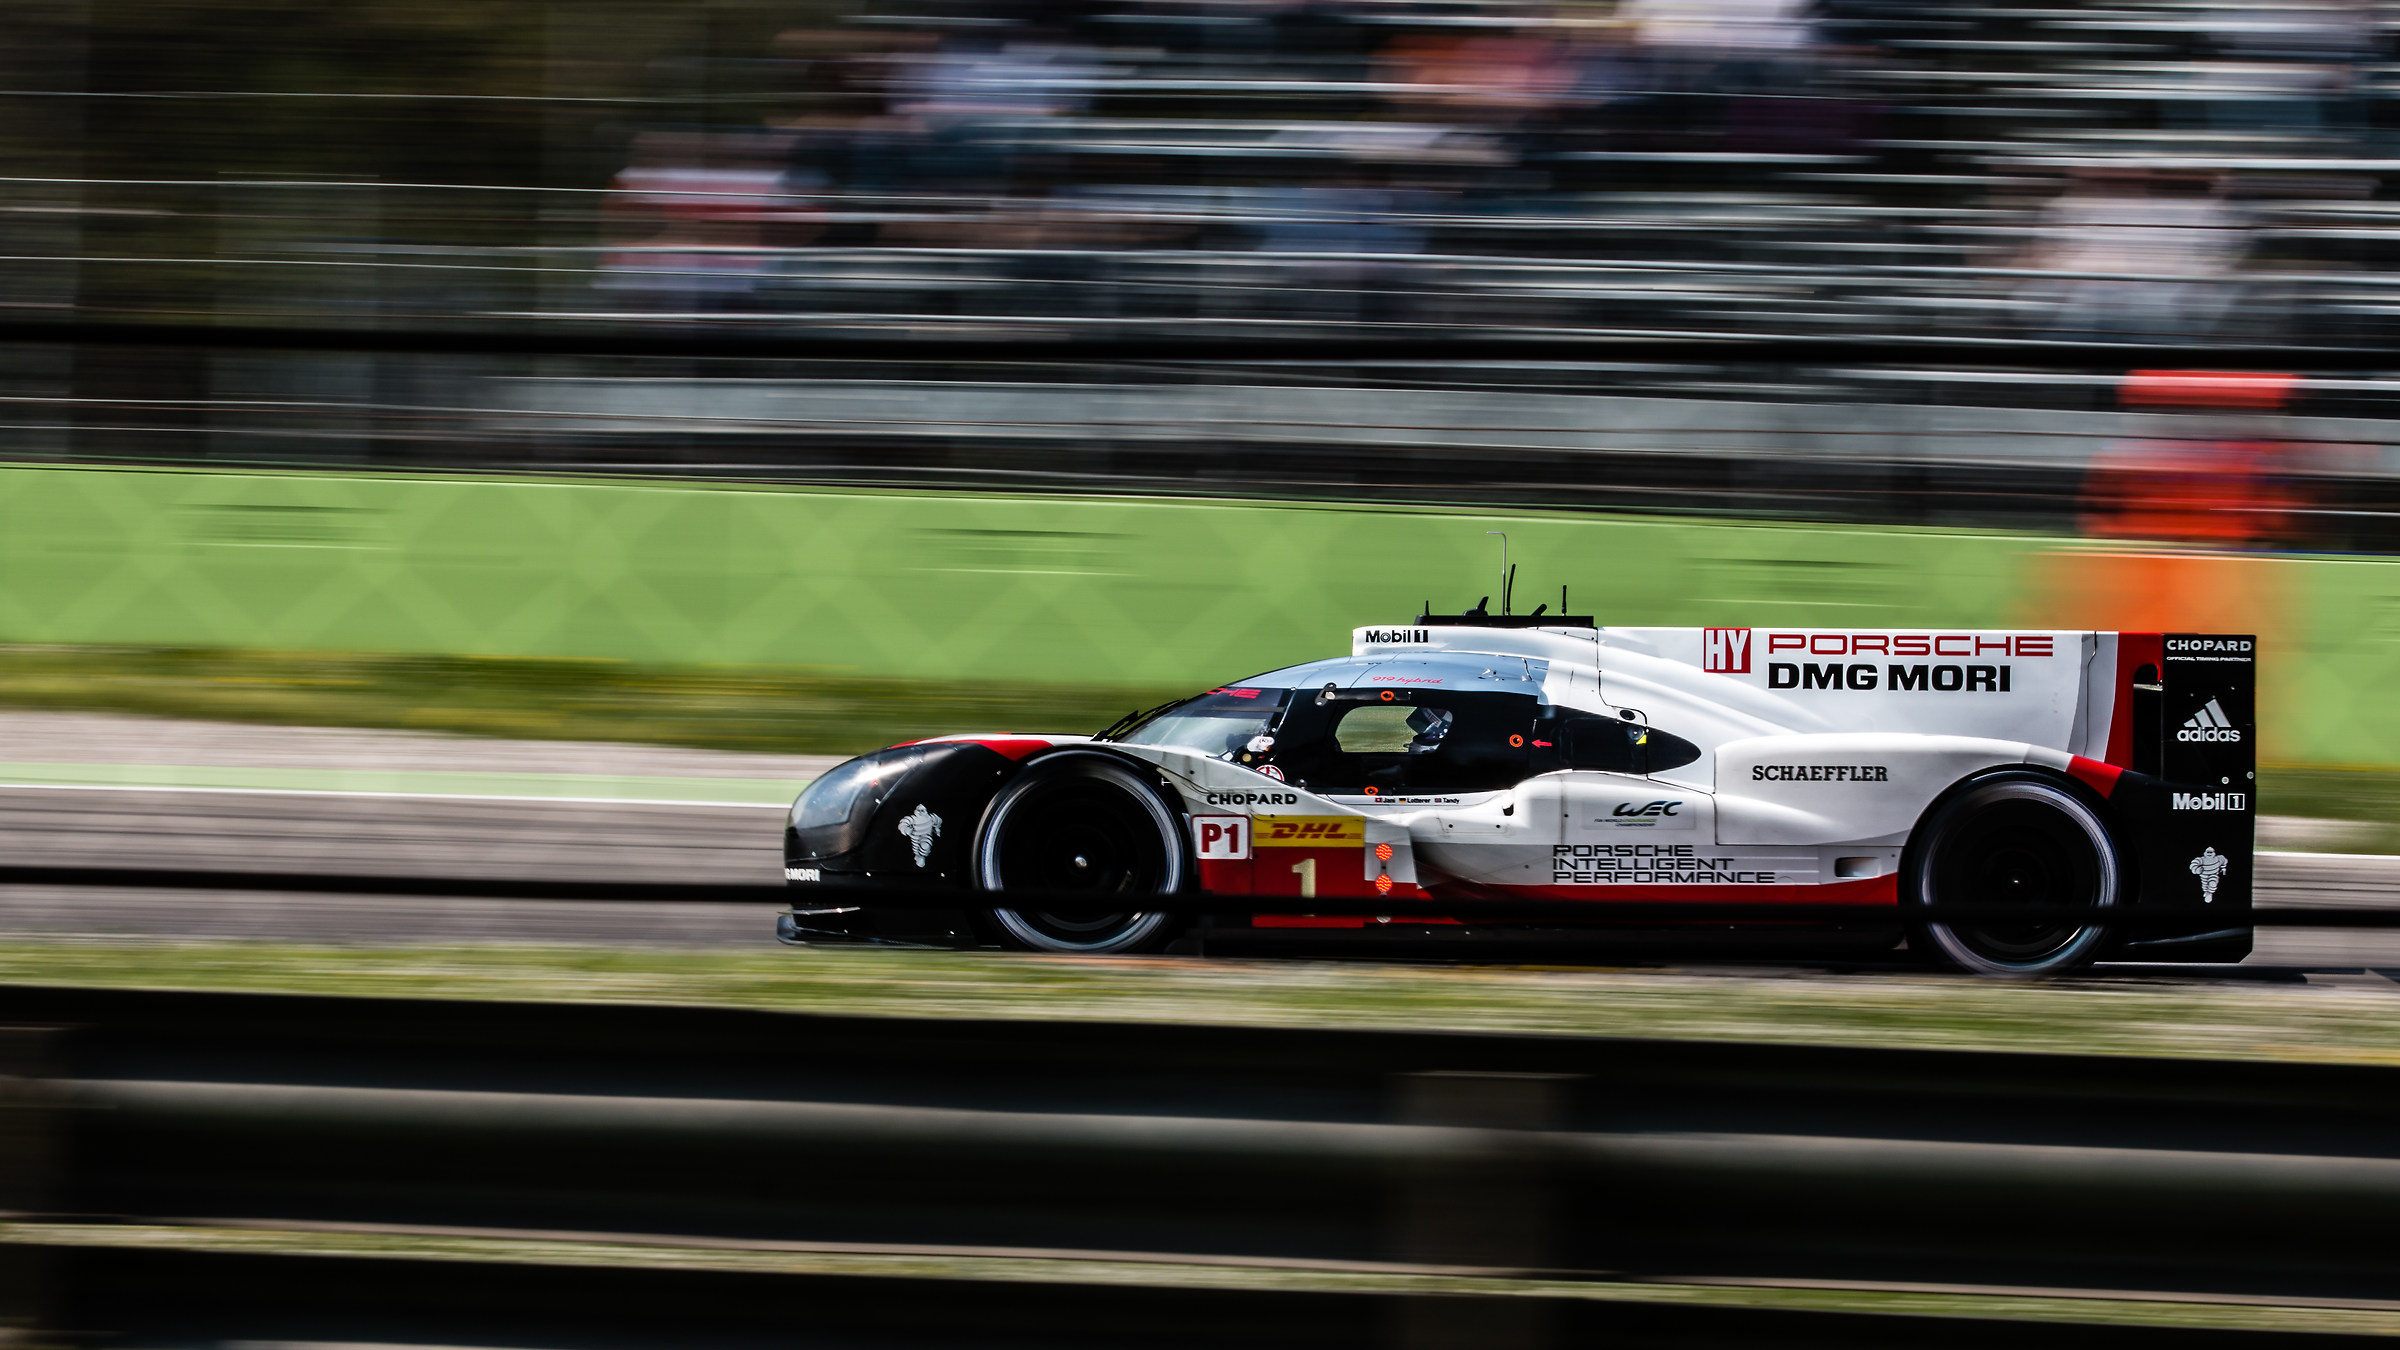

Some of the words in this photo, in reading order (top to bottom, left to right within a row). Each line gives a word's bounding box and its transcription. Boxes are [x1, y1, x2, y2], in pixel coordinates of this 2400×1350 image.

[1366, 630, 1411, 643] Mobil
[1415, 630, 1427, 643] 1
[1704, 629, 1749, 670] HY
[1768, 633, 2053, 657] PORSCHE
[2166, 639, 2252, 651] CHOPARD
[1768, 662, 1878, 690] DMG
[1888, 663, 2011, 692] MORI
[2177, 726, 2241, 742] adidas
[1752, 765, 1888, 781] SCHAEFFLER
[1206, 793, 1297, 805] CHOPARD
[2173, 793, 2226, 810] Mobil
[1612, 801, 1683, 816] WEC
[1201, 823, 1239, 853] P1
[1270, 823, 1347, 839] DHL
[1553, 845, 1693, 857] PORSCHE
[1553, 858, 1735, 870] INTELLIGENT
[1291, 858, 1316, 898] 1
[1553, 871, 1775, 883] PERFORMANCE
